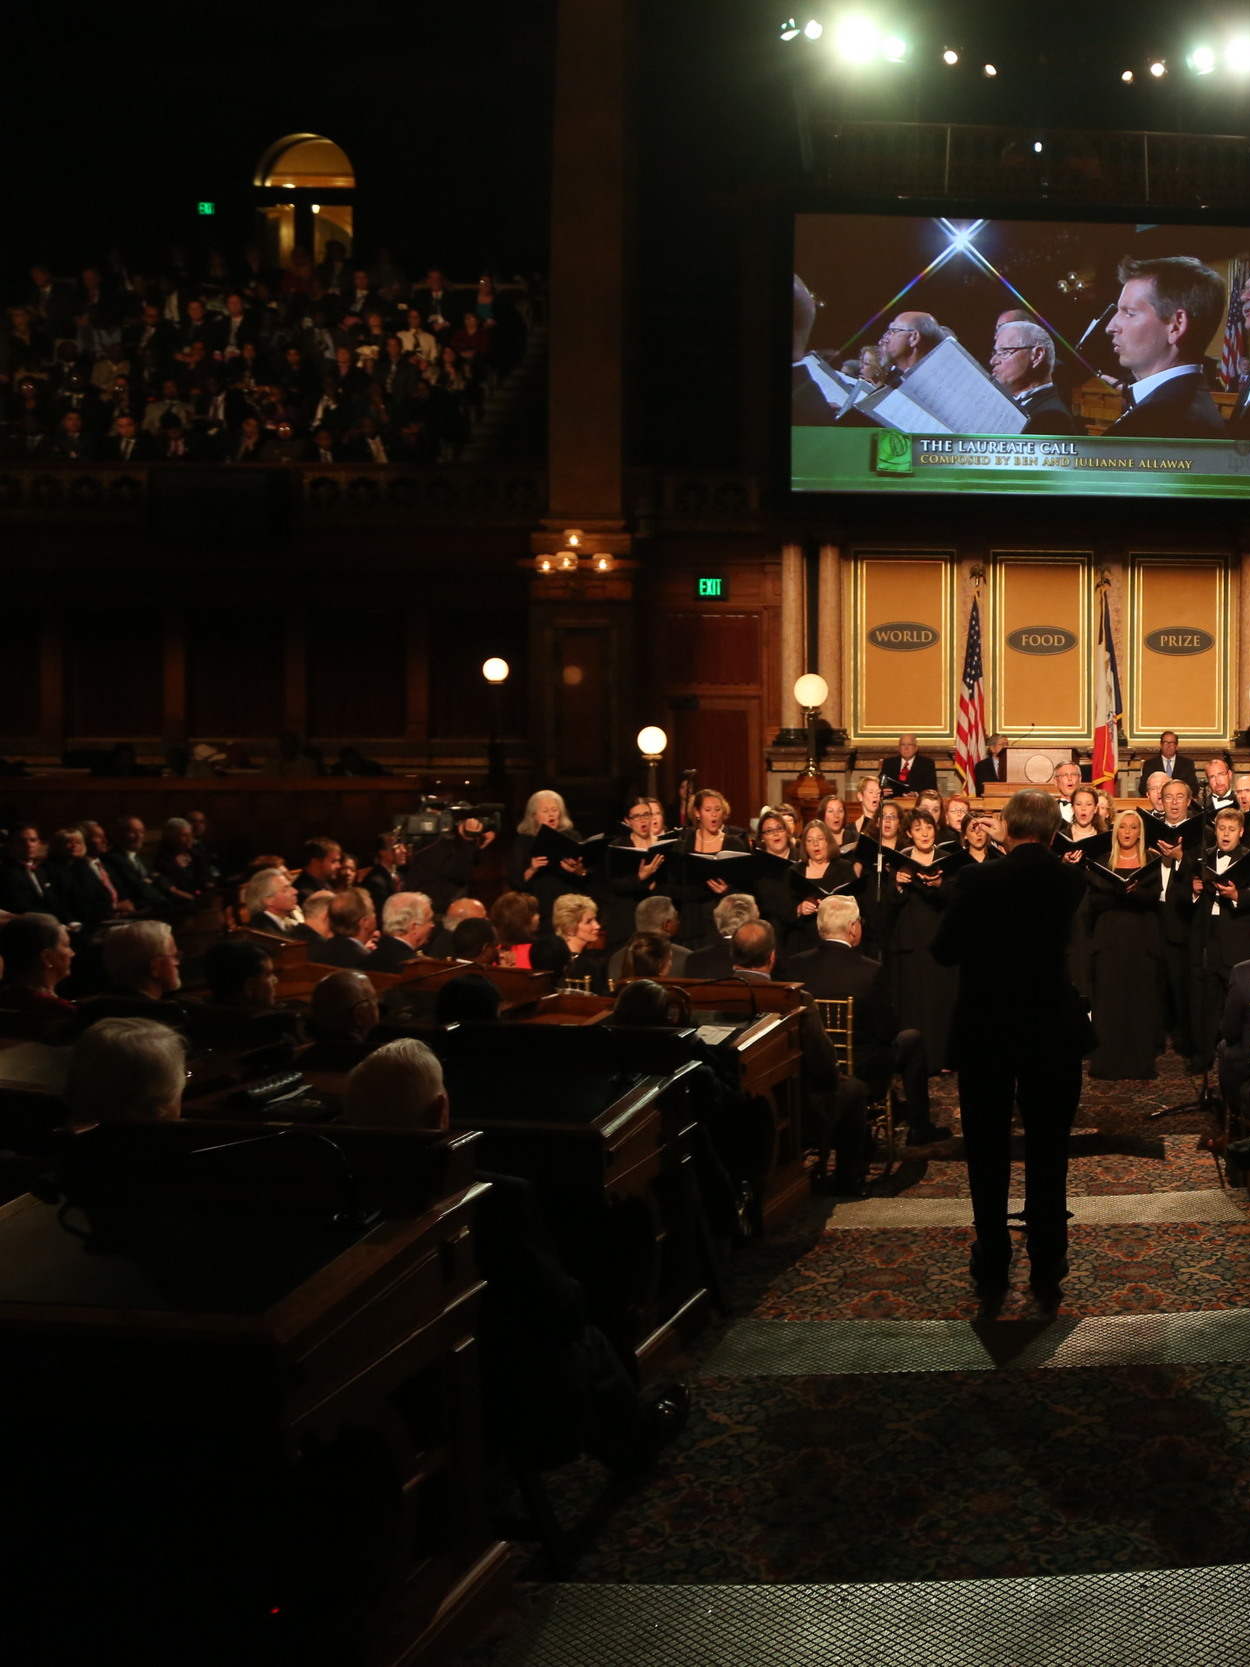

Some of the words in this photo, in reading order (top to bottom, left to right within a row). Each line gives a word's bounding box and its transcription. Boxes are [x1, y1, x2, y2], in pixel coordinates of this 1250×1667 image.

[920, 440, 953, 453] THE
[958, 440, 1035, 455] LAUREATE
[1040, 442, 1078, 455] CALL
[920, 455, 991, 466] COMPOSED
[995, 456, 1010, 467] BY
[1014, 457, 1038, 467] BEN
[1042, 457, 1070, 467] AND
[1074, 458, 1134, 469] JULIANNE
[1139, 460, 1193, 469] ALLAWAY
[699, 578, 722, 596] EXIT
[875, 630, 933, 643] WORLD
[1021, 634, 1066, 648] FOOD
[1159, 634, 1201, 648] PRIZE
